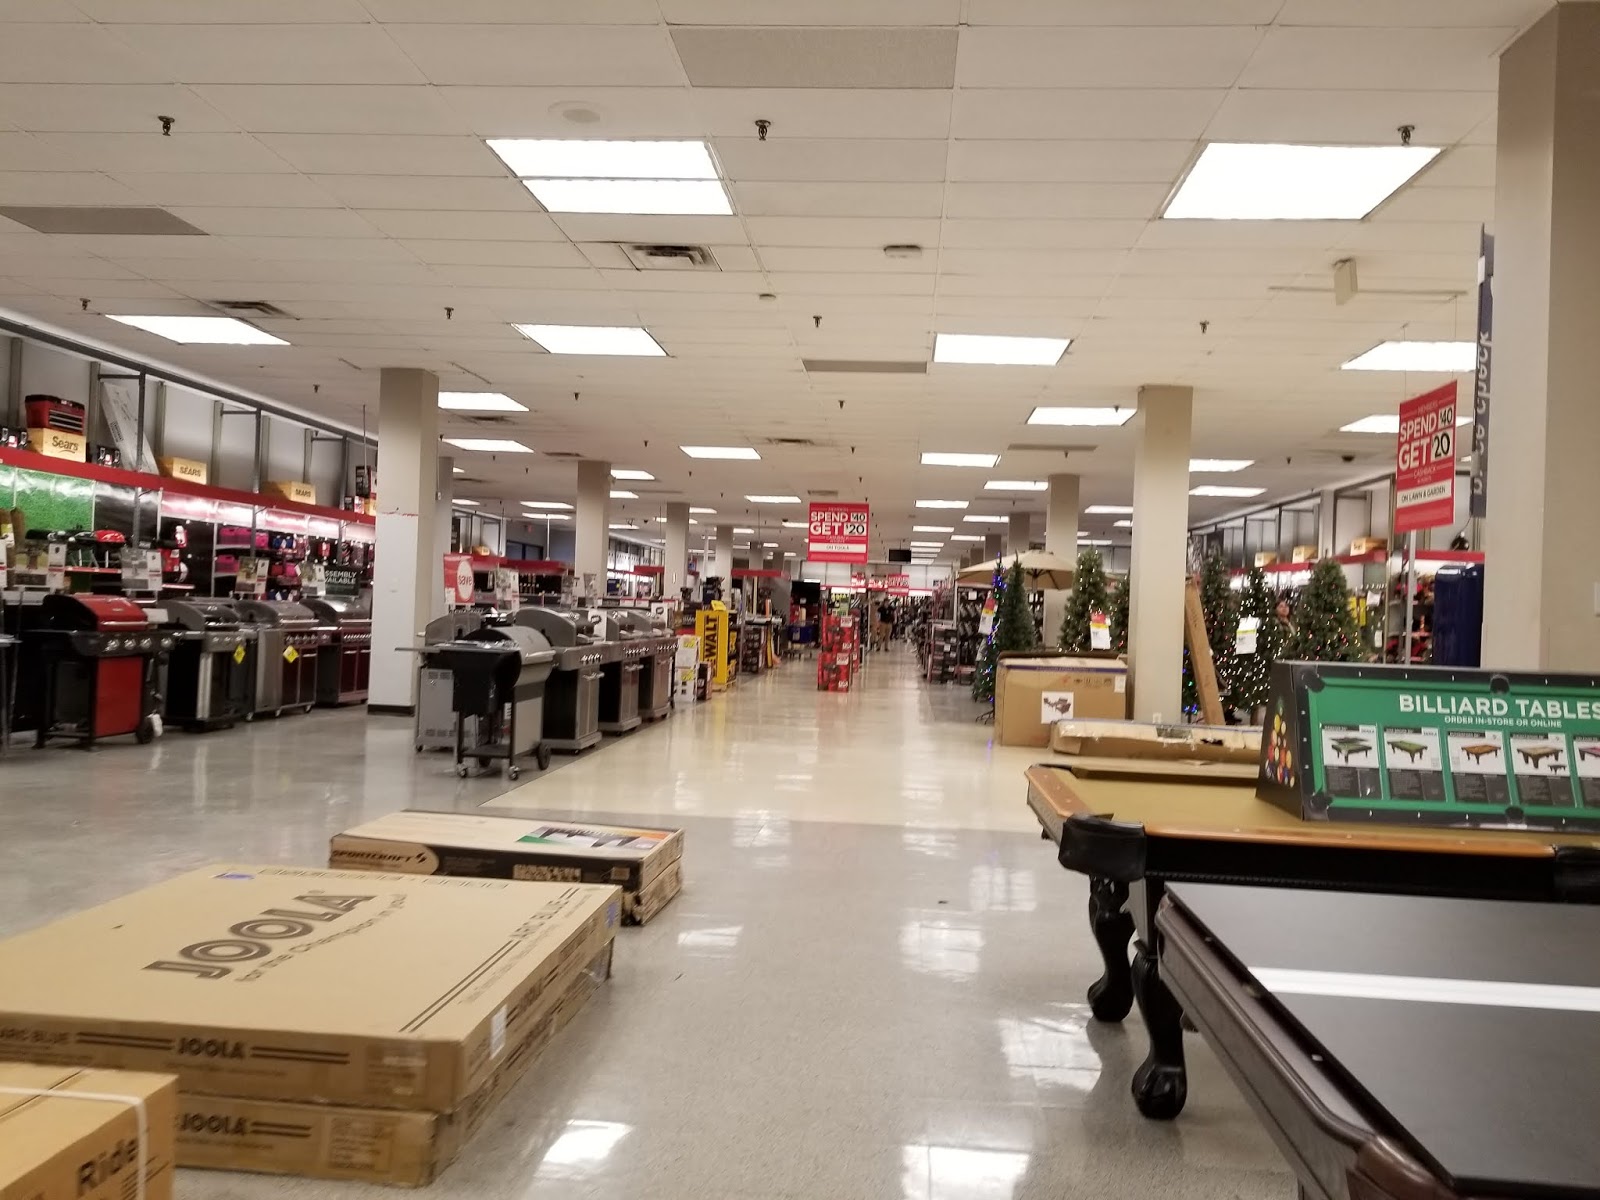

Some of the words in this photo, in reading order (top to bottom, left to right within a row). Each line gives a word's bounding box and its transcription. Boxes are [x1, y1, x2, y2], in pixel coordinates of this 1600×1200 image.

[1400, 411, 1437, 443] SPEND
[51, 435, 79, 451] Sears
[1398, 437, 1430, 471] GET
[179, 466, 201, 477] SEARS
[1401, 494, 1408, 503] ON
[1409, 491, 1423, 501] LAWN
[1427, 485, 1446, 498] GARDEN
[810, 511, 849, 522] SPEND
[810, 521, 842, 535] GET
[324, 570, 357, 578] SSEMBLY
[458, 575, 473, 586] save
[705, 615, 717, 677] EWALT
[1400, 694, 1508, 716] BILLIARD
[1444, 715, 1474, 725] ORDER
[1475, 716, 1514, 727] IN-STORE
[1515, 718, 1529, 727] OR
[1530, 719, 1562, 729] ONLINE
[140, 894, 378, 980] JOOLA
[177, 1037, 246, 1060] JOOLA
[180, 1112, 249, 1136] JOOLA
